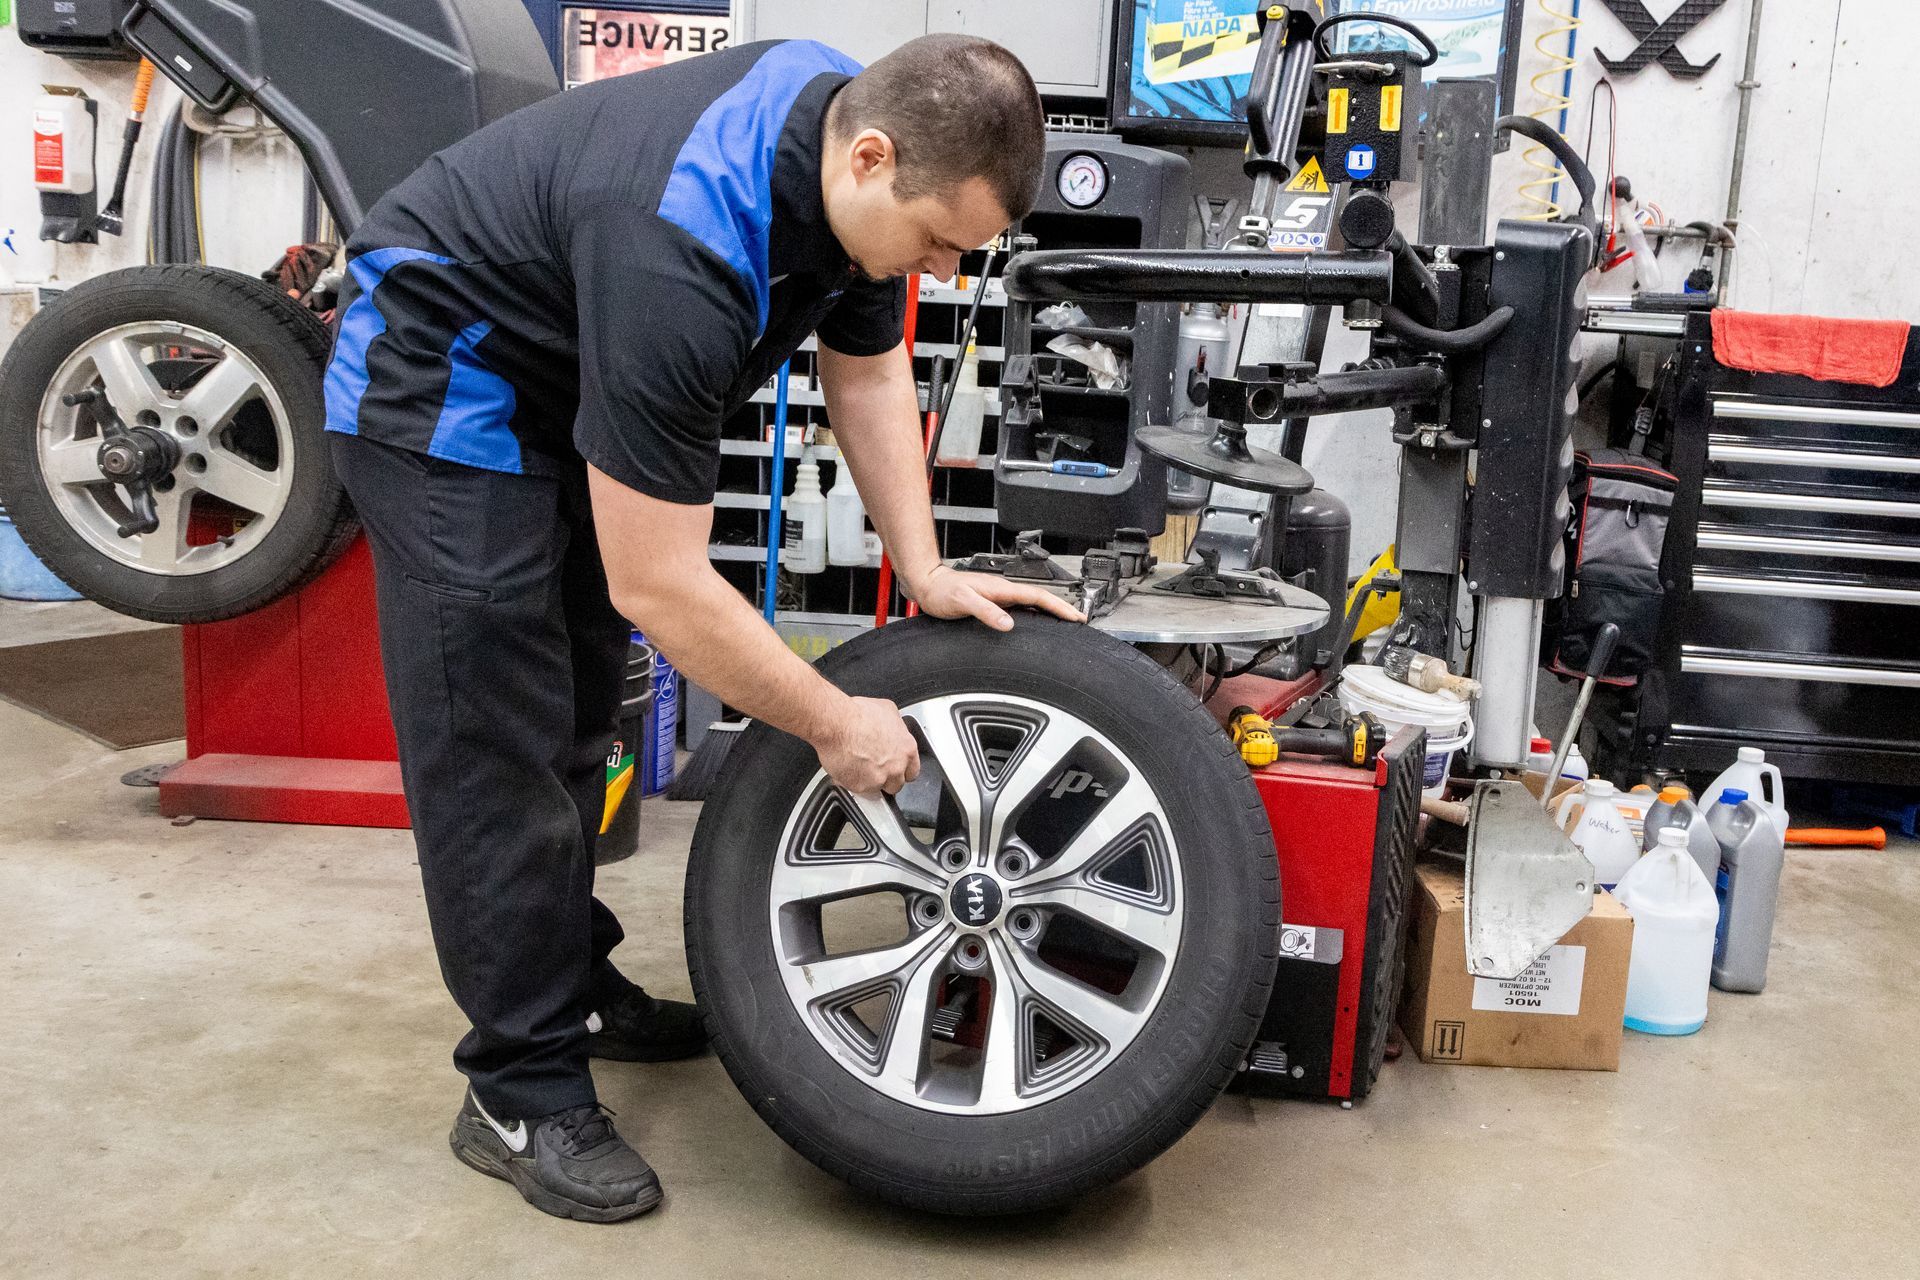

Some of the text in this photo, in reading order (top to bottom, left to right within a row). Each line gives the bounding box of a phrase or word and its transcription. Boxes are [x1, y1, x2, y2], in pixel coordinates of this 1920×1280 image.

[1182, 17, 1242, 38] NAPA
[966, 877, 986, 921] KIA
[1499, 982, 1534, 990] OPTIMIZER
[1504, 997, 1542, 1007] MOC
